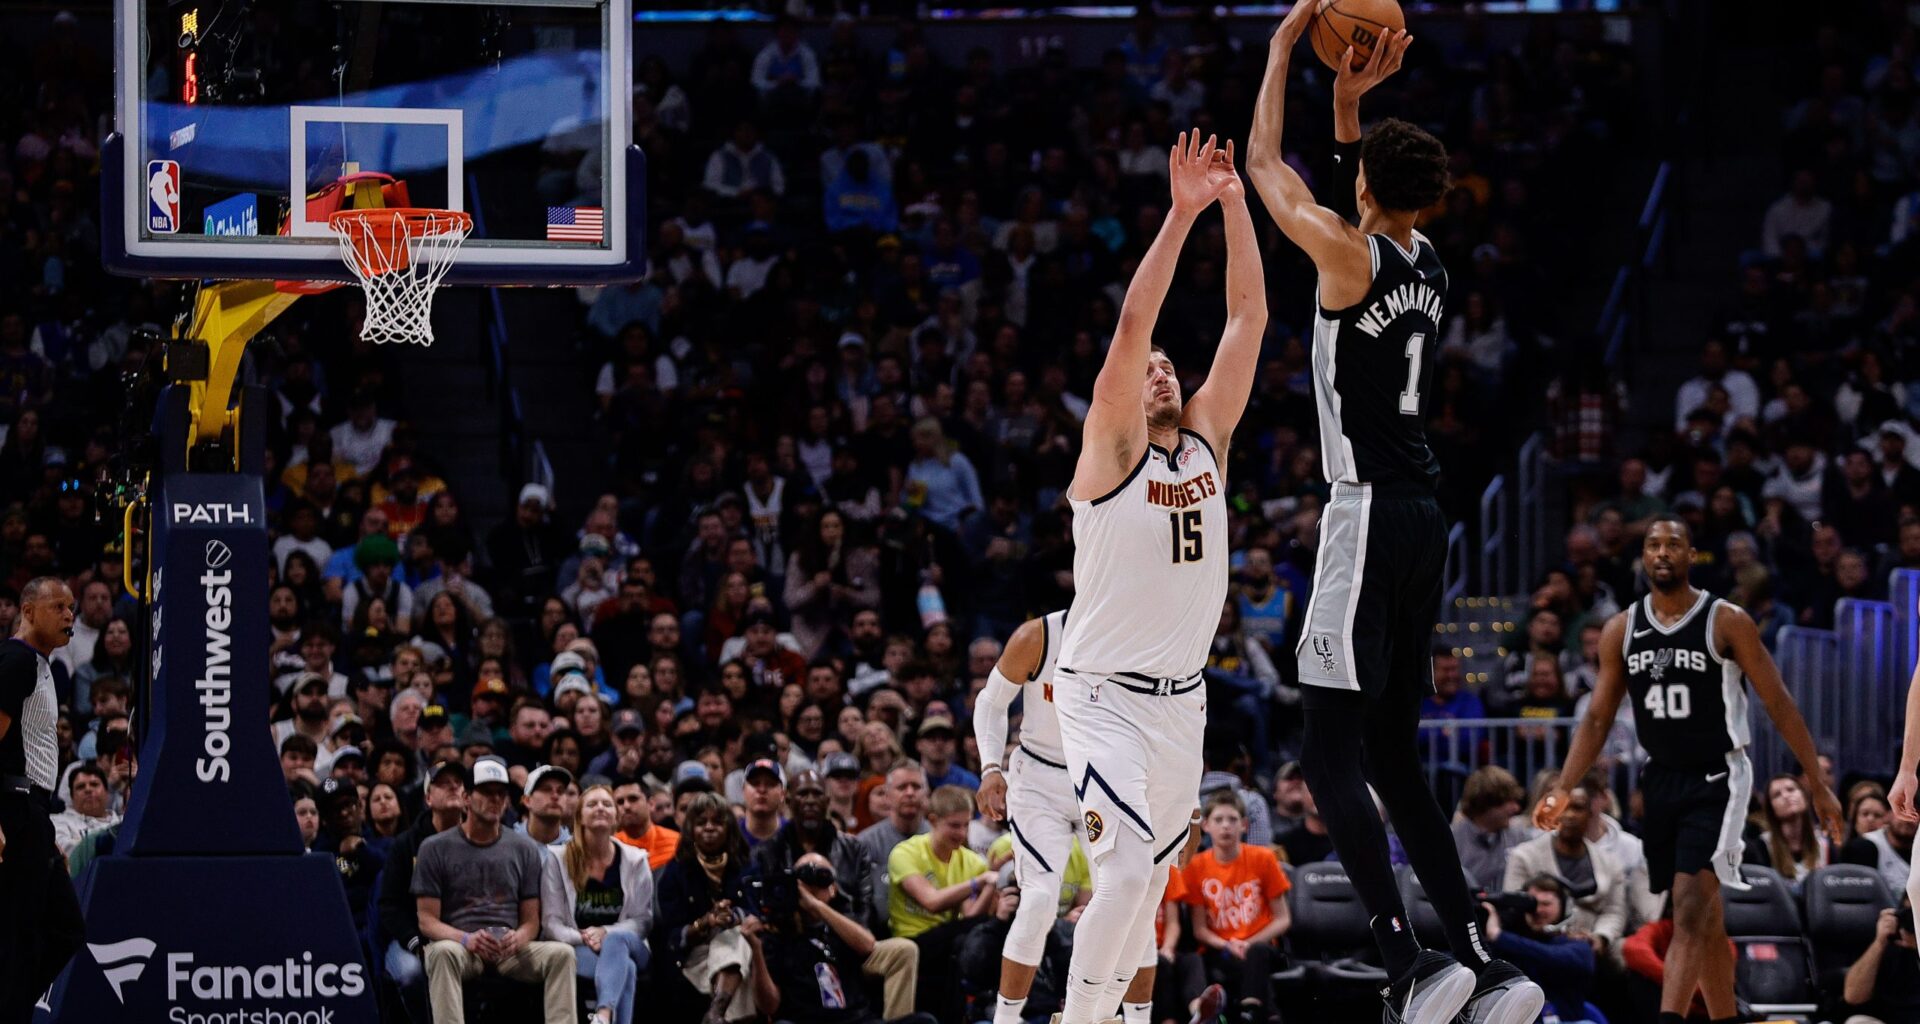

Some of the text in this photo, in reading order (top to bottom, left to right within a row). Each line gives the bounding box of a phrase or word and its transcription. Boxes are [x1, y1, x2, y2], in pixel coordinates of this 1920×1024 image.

[152, 216, 168, 229] NBA
[1398, 332, 1425, 416] 1
[1147, 471, 1217, 509] NUGGETS
[1169, 509, 1203, 564] 15
[195, 569, 232, 783] Southwest
[1644, 684, 1691, 719] 40
[167, 951, 365, 1000] Fanatics
